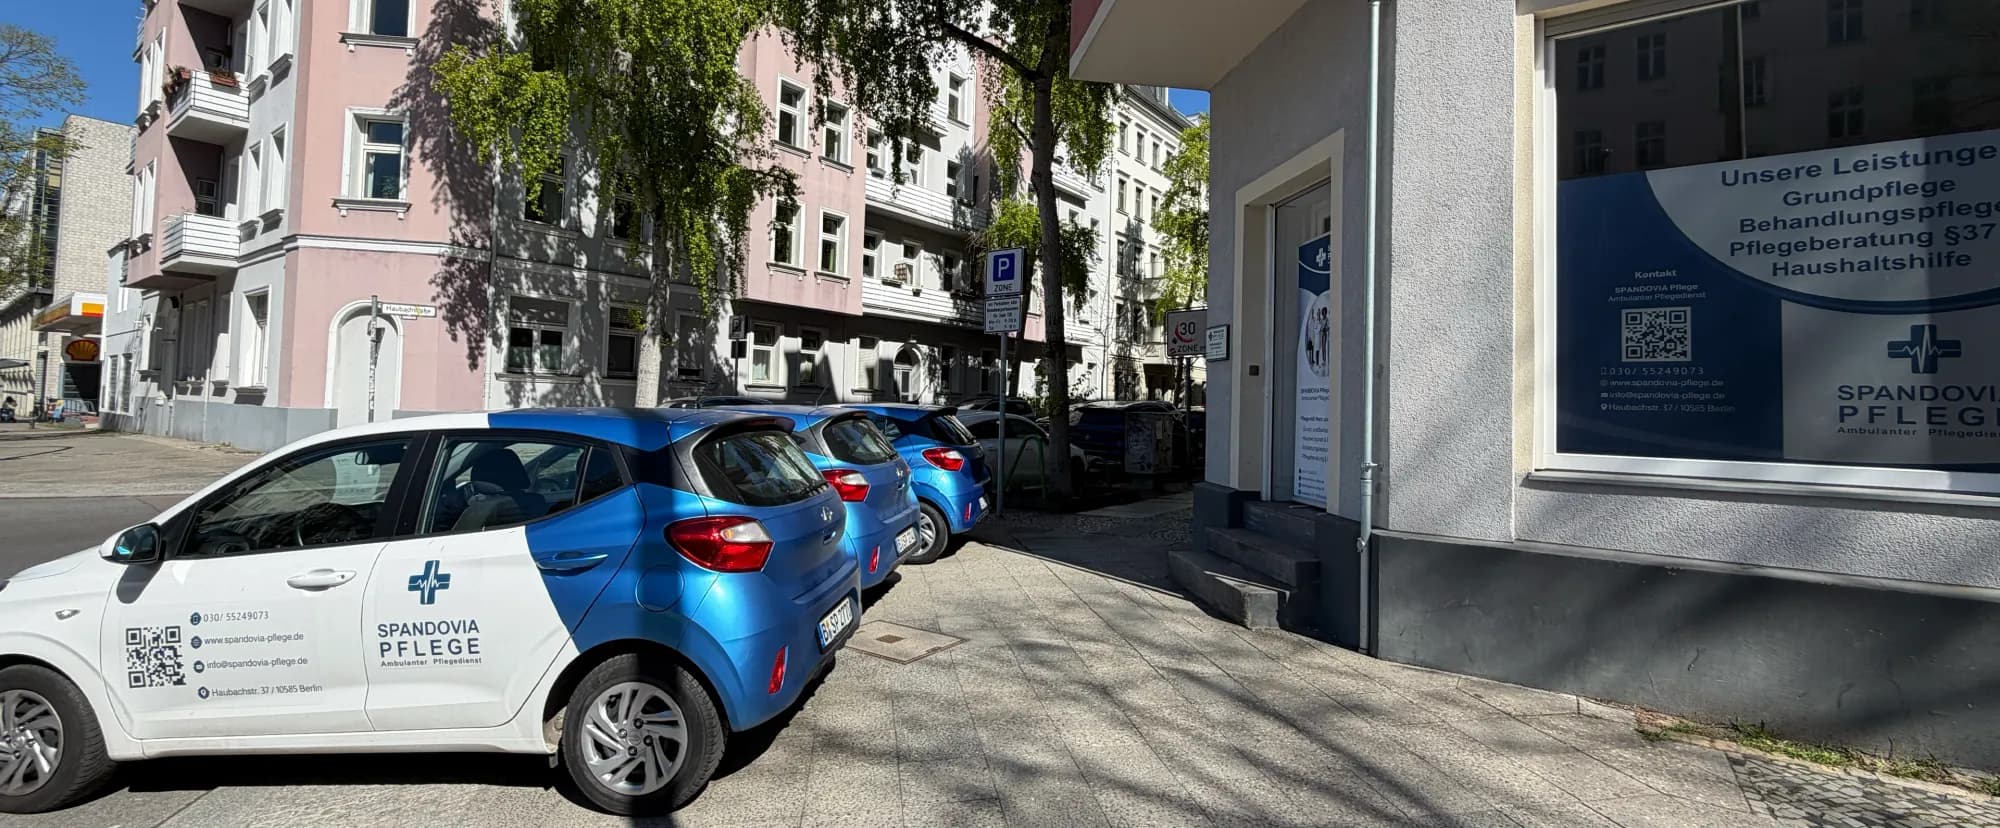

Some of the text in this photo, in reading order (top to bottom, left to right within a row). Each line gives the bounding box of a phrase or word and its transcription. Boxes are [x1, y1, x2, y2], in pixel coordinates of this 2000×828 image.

[1721, 163, 1822, 187] Unsere
[1782, 180, 1957, 207] Grundpflege
[1730, 223, 1997, 257] Pflegeberatung §37
[998, 258, 1010, 278] P
[1772, 250, 1973, 277] Haushaltshilfe
[1634, 269, 1678, 279] Kontakt
[993, 284, 1013, 292] ZONE
[1615, 283, 1699, 294] SPANDOVIA Pflege
[1180, 321, 1196, 336] 30
[1177, 344, 1199, 353] ZONE
[1609, 367, 1704, 376] 030/ 55249073
[1837, 384, 2000, 402] SPANDOVI
[1837, 426, 1918, 437] Ambulanter
[203, 611, 269, 623] 030/ 55249073
[377, 619, 481, 638] SPANDOVIA
[821, 623, 829, 642] B
[204, 632, 304, 646] www.spandovia-pflege.de
[379, 638, 481, 658] PFLEGE
[206, 656, 308, 670] info@spandovia-pflege.de
[381, 657, 482, 668] Ambulanter Pflegedienst
[211, 687, 259, 698] Haubachstr.
[260, 685, 270, 695] 37
[275, 684, 298, 695] 10585
[299, 683, 323, 693] Berlin
